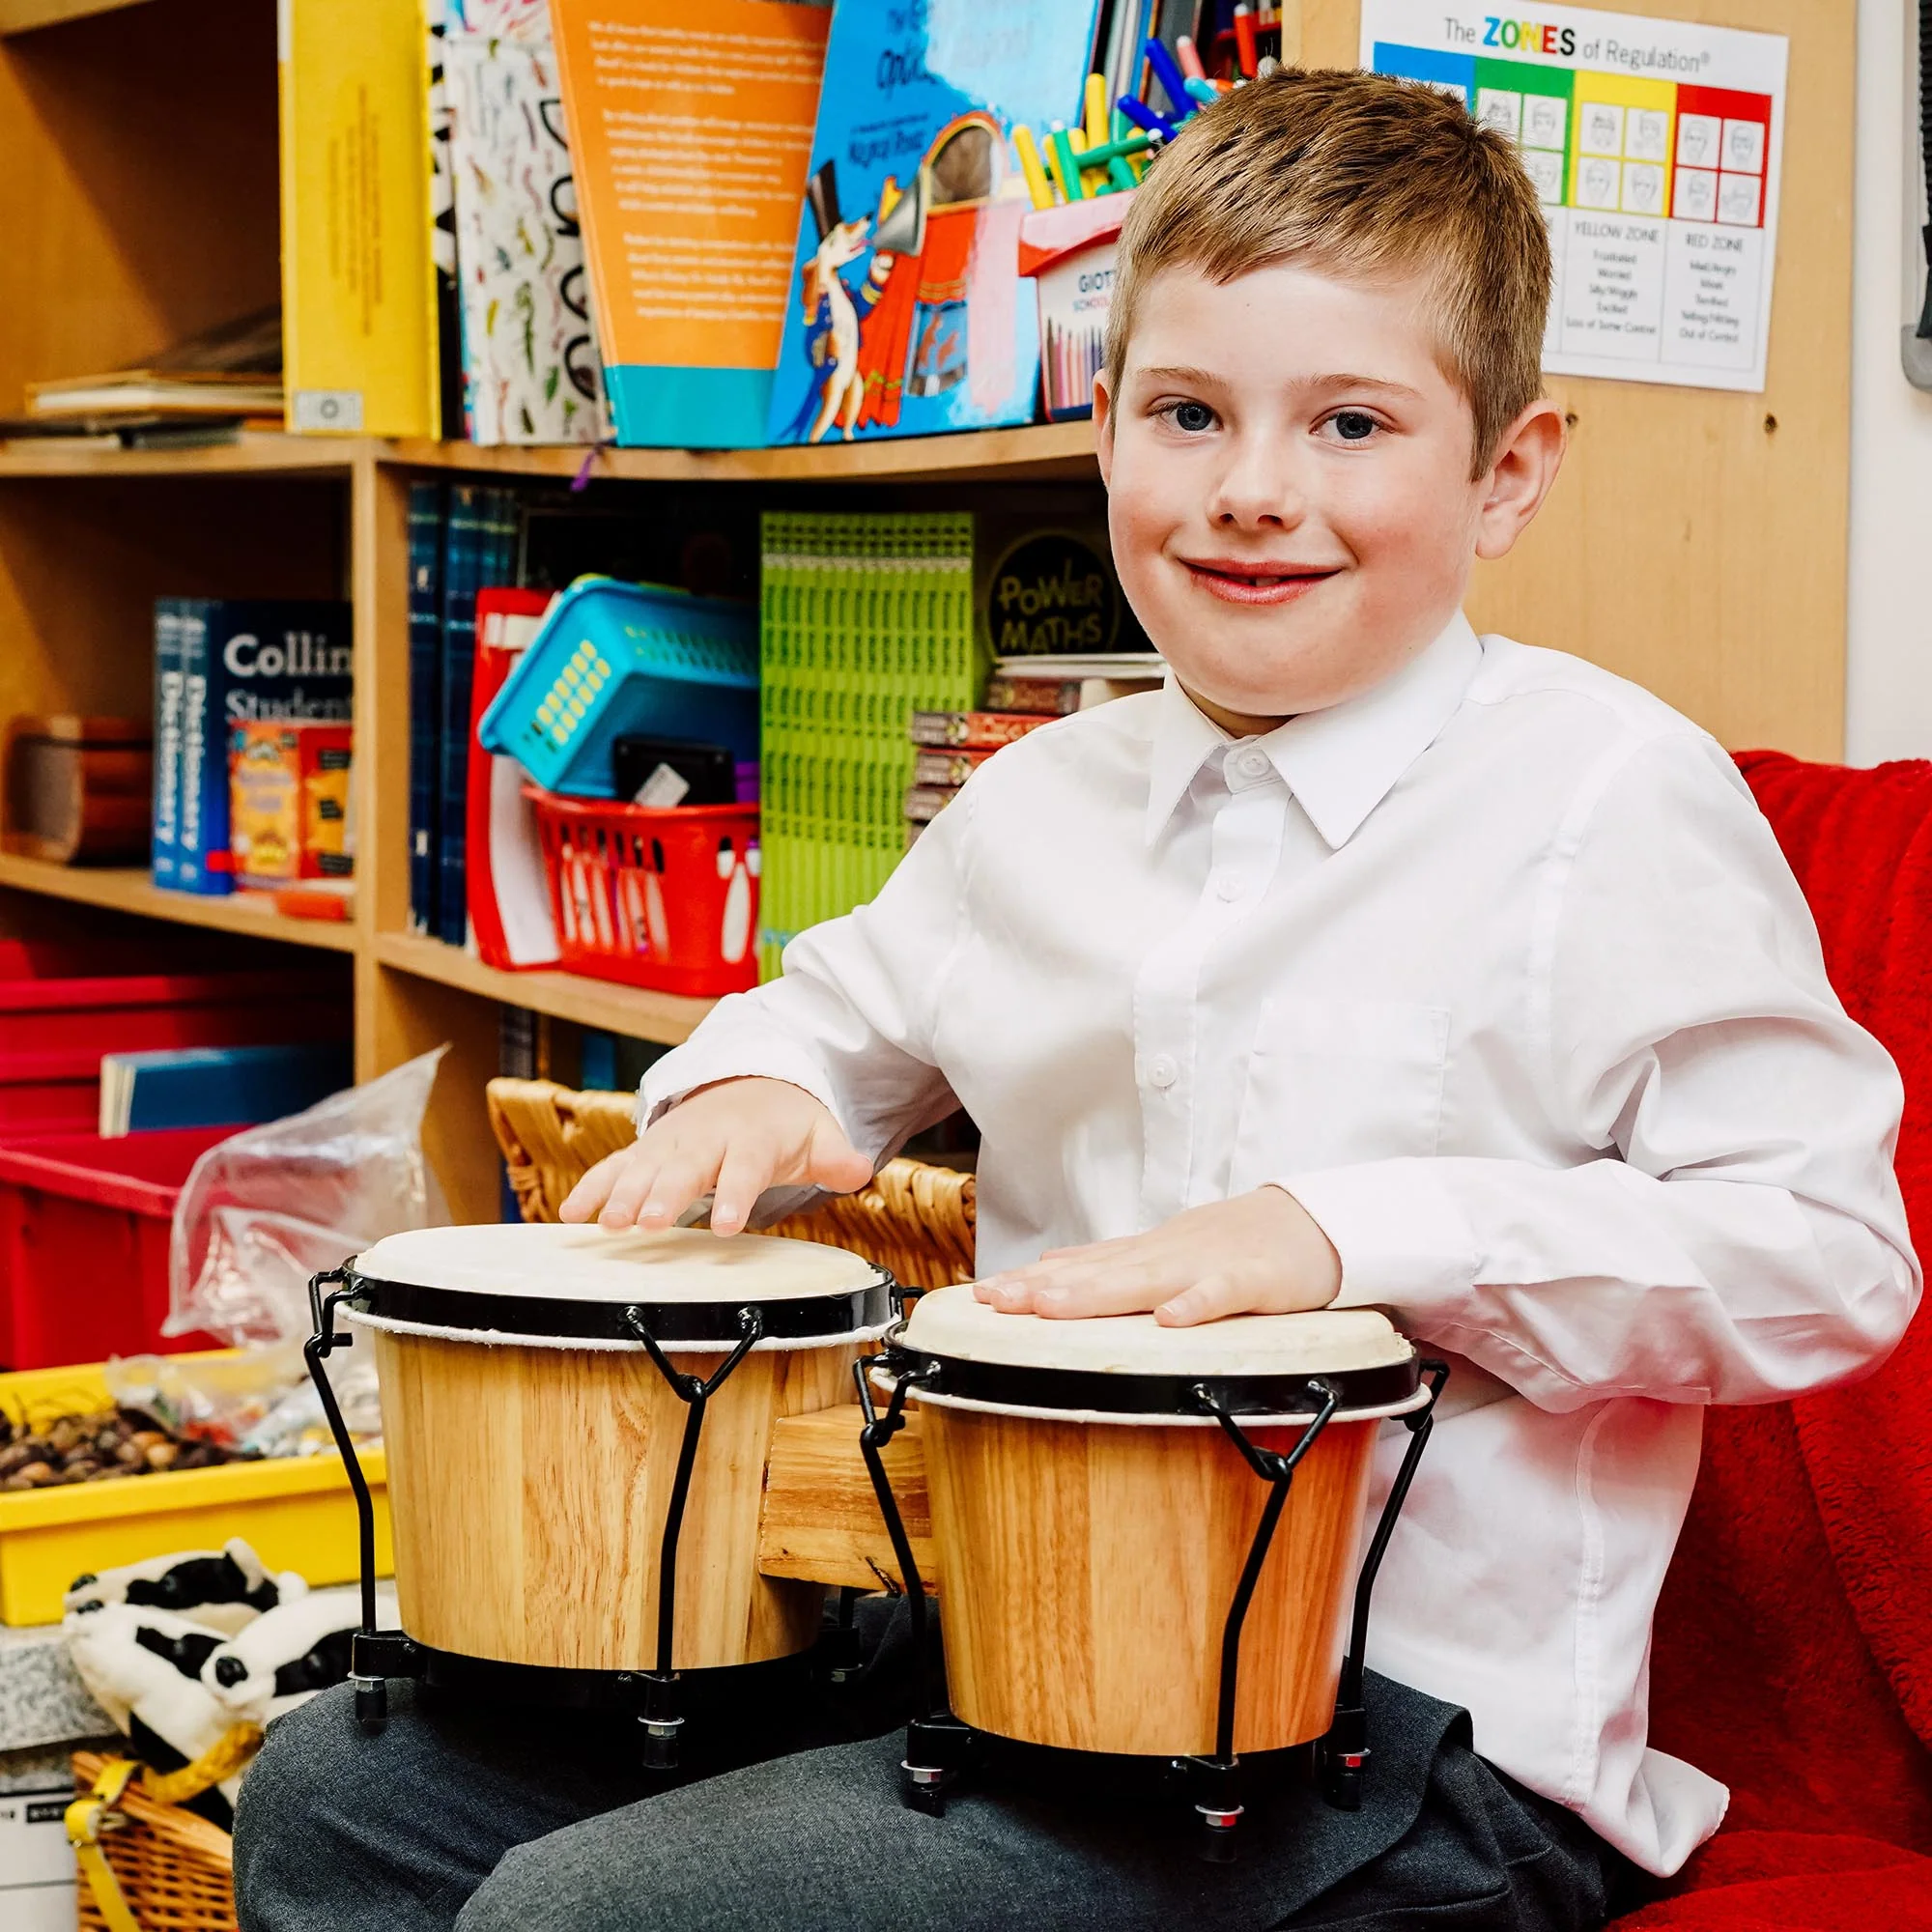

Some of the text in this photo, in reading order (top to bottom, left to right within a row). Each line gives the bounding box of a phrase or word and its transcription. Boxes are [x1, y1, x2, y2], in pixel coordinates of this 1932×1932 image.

[1444, 17, 1476, 43] The
[1482, 16, 1576, 56] ZONES
[1583, 40, 1600, 60] of
[1576, 222, 1659, 242] YELLOW ZONE
[1686, 233, 1744, 252] RED ZONE
[998, 557, 1103, 615] POWER
[1000, 612, 1103, 654] MATHS
